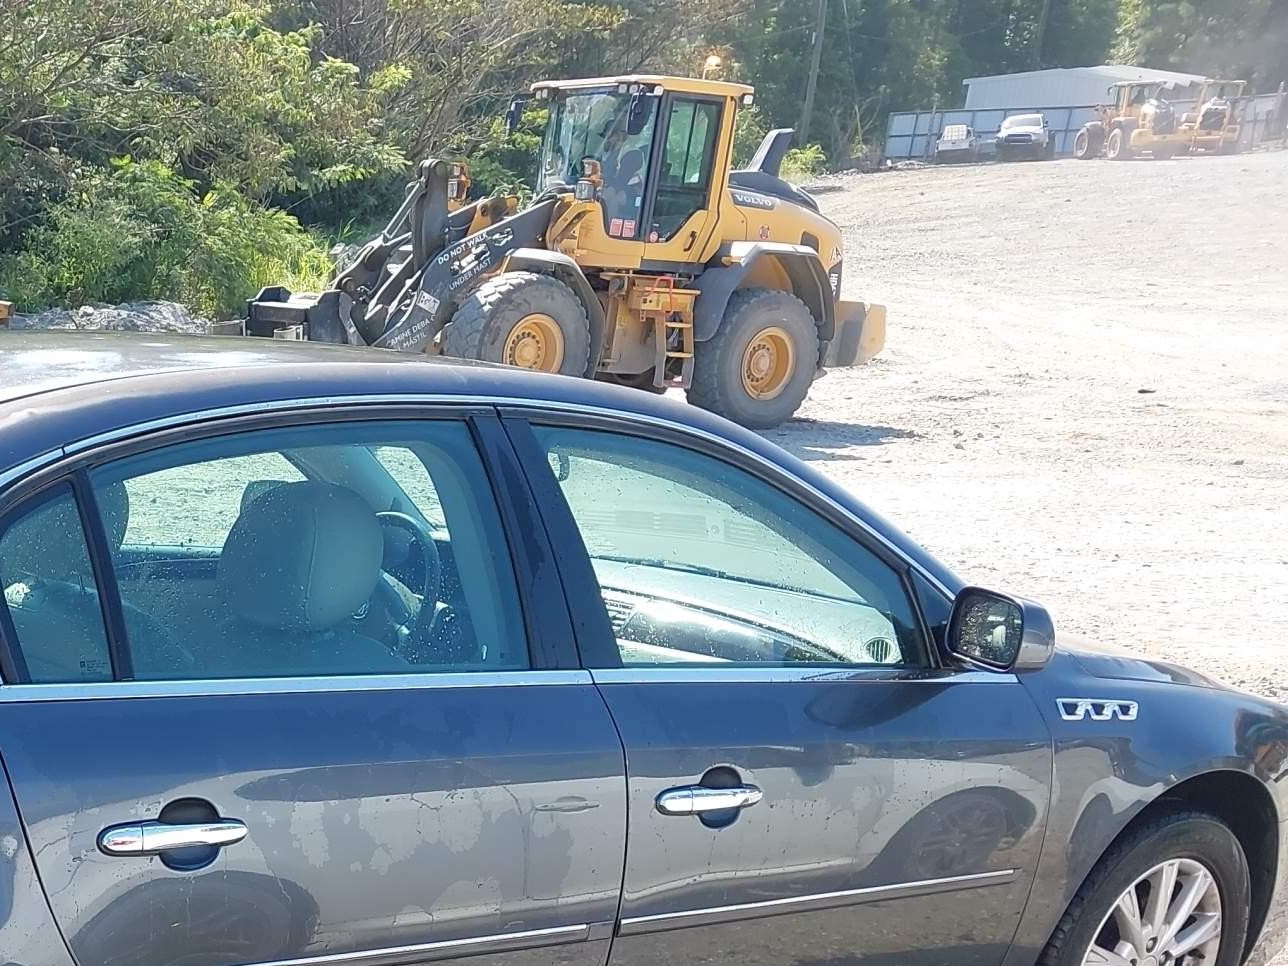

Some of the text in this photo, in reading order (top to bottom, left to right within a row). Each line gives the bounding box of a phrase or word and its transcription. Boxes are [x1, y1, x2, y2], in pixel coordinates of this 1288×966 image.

[734, 194, 772, 206] VOLVO
[438, 232, 489, 265] DO NOT WALK
[449, 256, 492, 290] UNDER MAST
